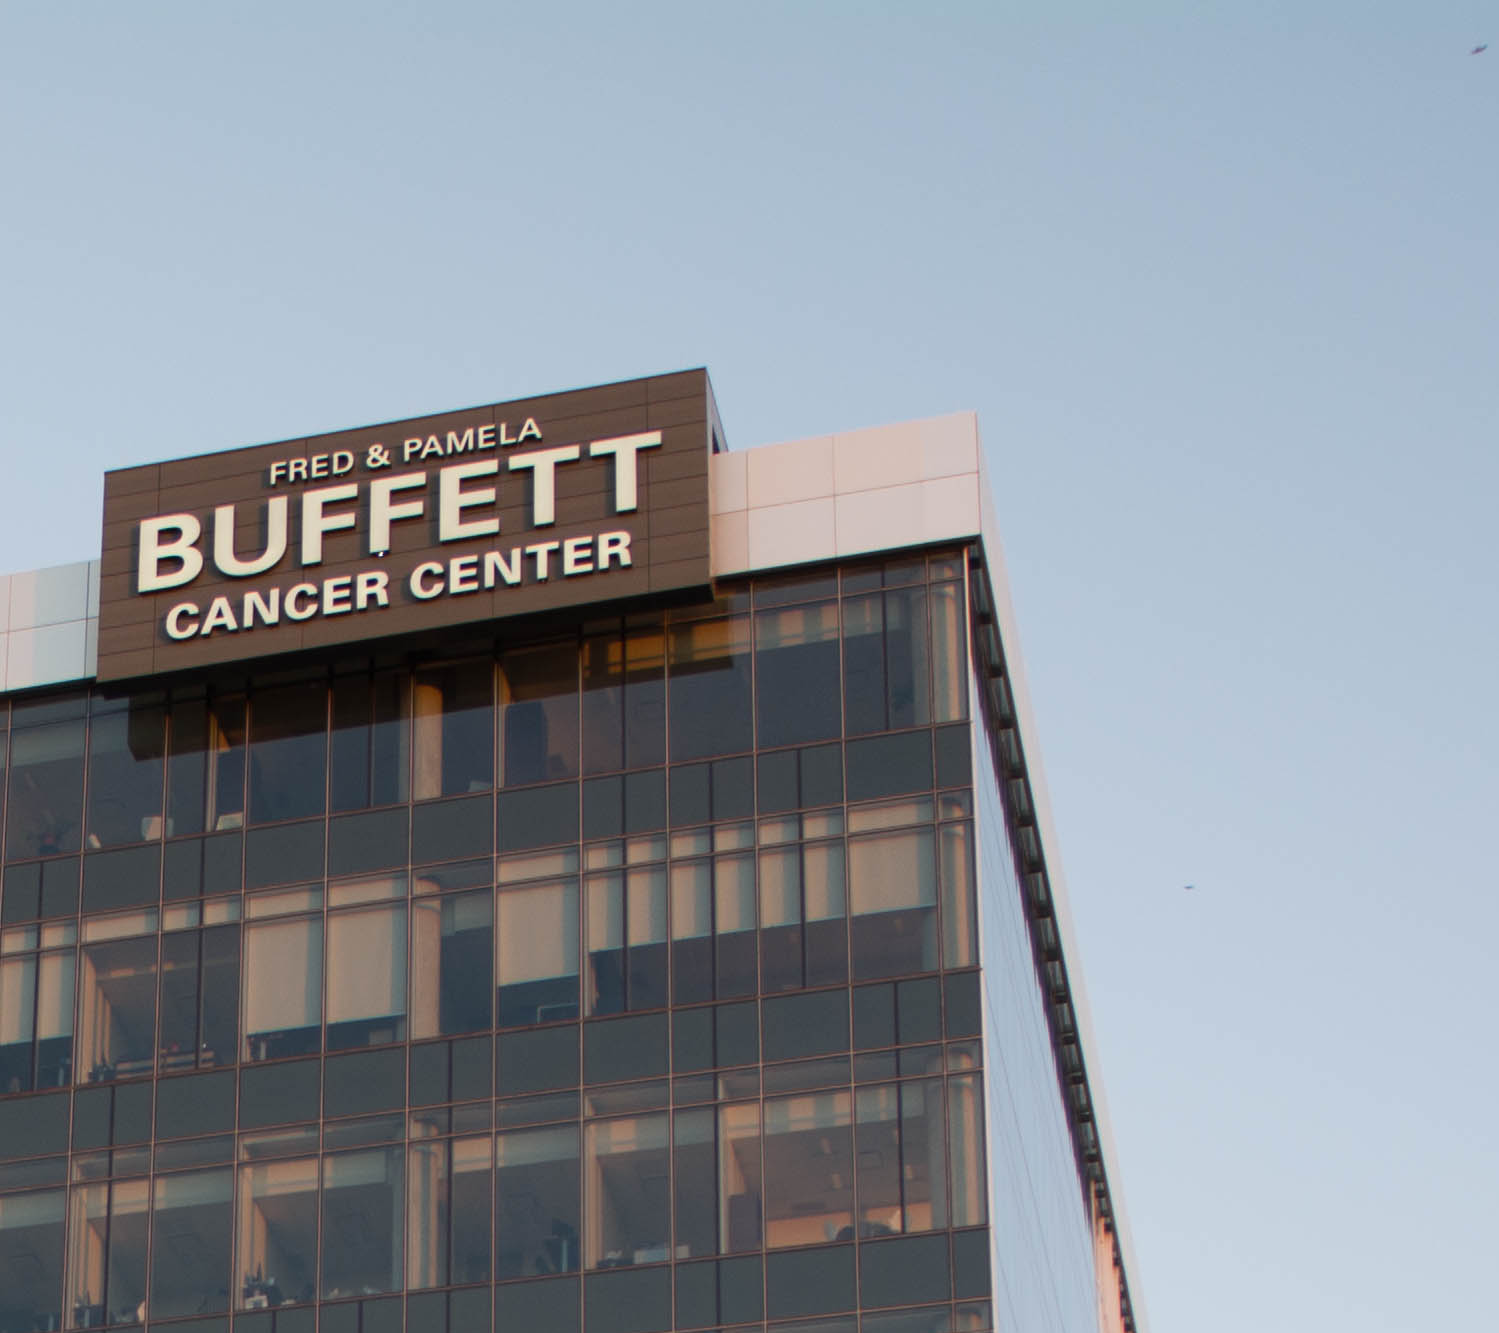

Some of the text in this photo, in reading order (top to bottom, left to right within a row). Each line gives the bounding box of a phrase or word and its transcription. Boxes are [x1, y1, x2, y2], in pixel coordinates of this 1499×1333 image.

[269, 417, 543, 487] FRED & PAMELA
[136, 430, 663, 594] BUFFETT
[164, 530, 634, 641] CANCER CENTER
